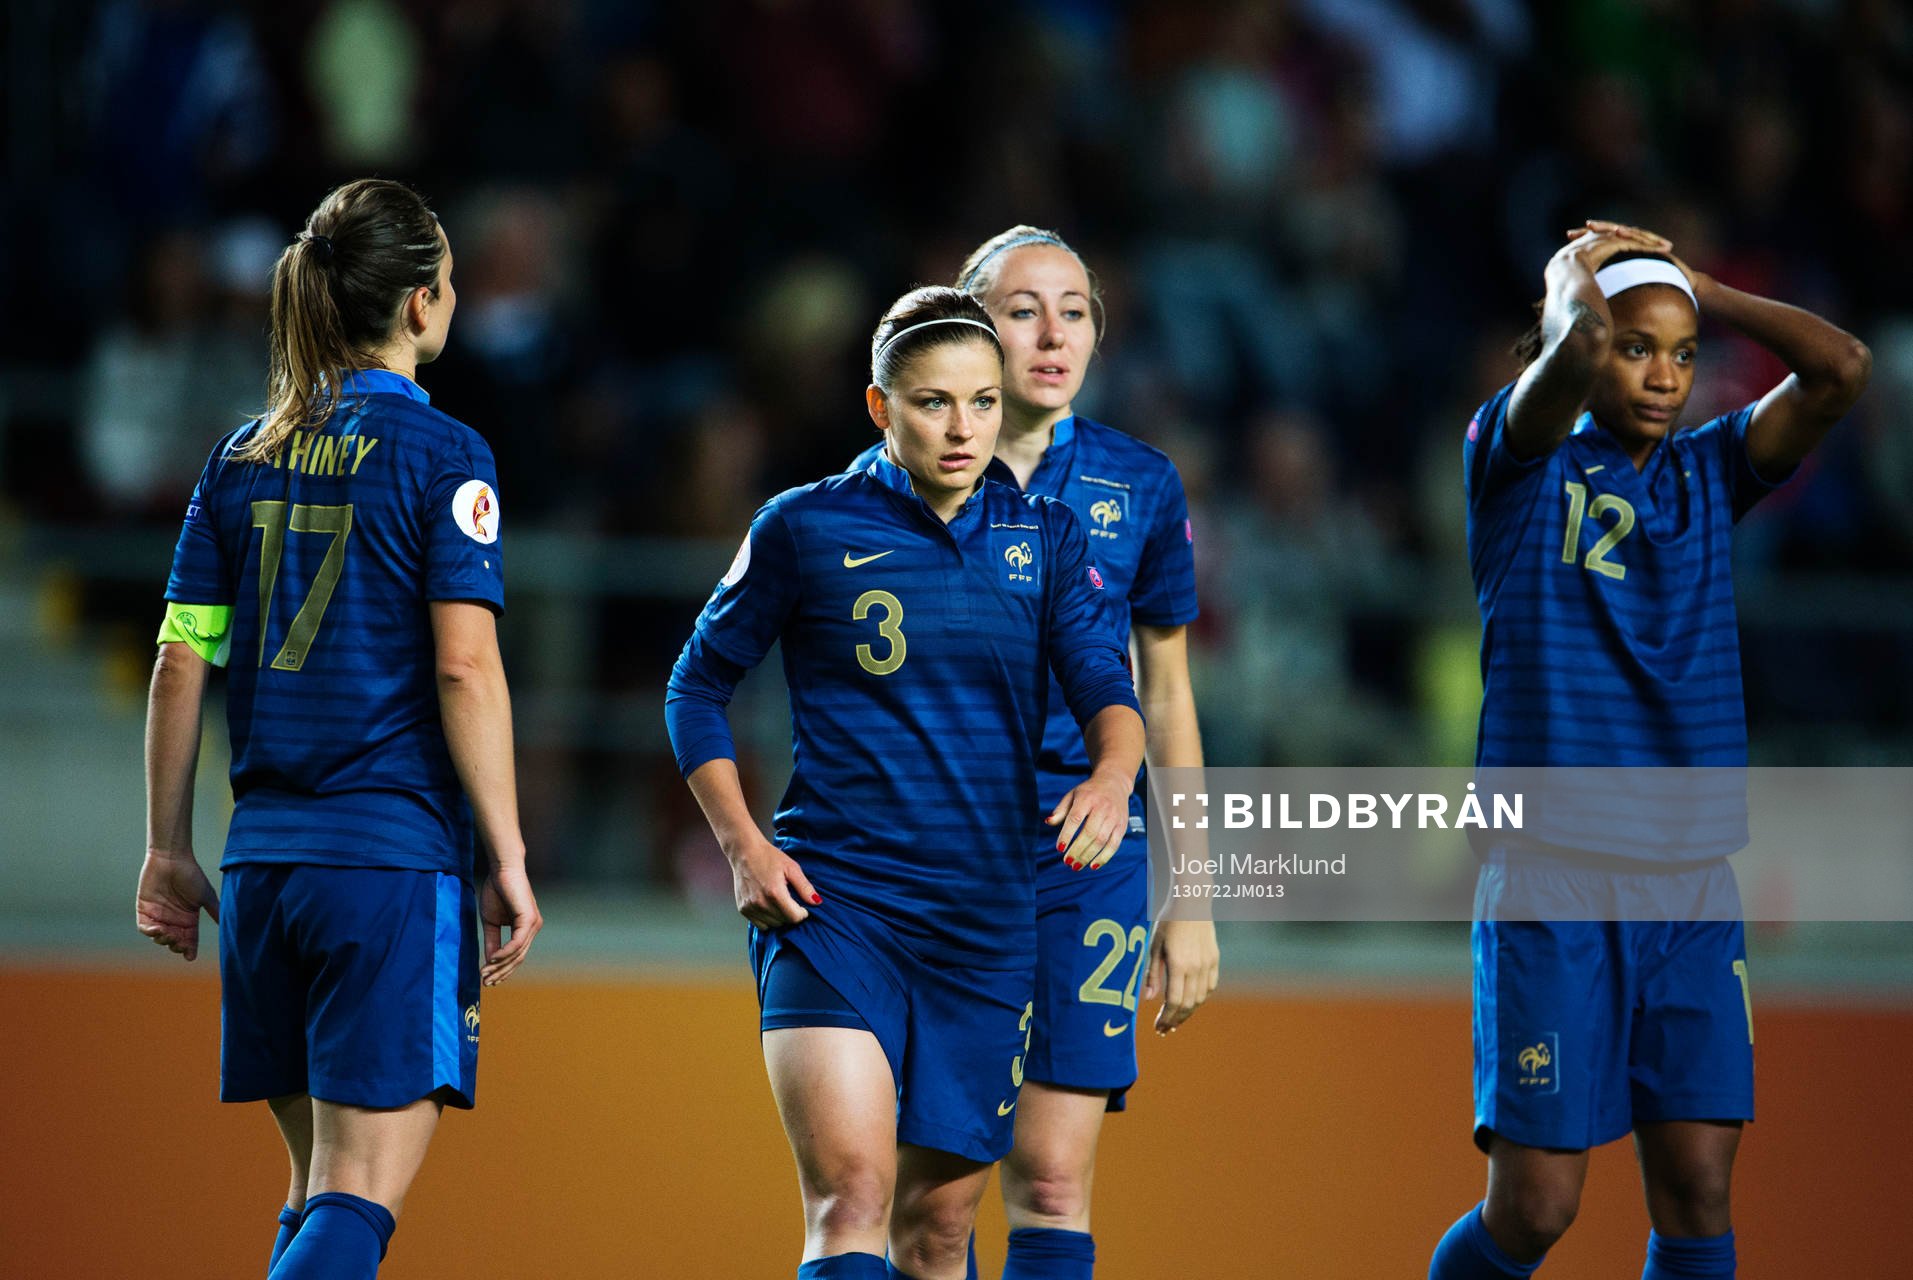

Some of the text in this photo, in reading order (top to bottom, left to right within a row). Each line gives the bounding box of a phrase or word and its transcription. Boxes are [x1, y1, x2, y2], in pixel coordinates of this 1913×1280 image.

[1561, 480, 1636, 581] 12
[250, 500, 354, 672] 17
[852, 589, 907, 676] 3
[1078, 918, 1148, 1012] 22
